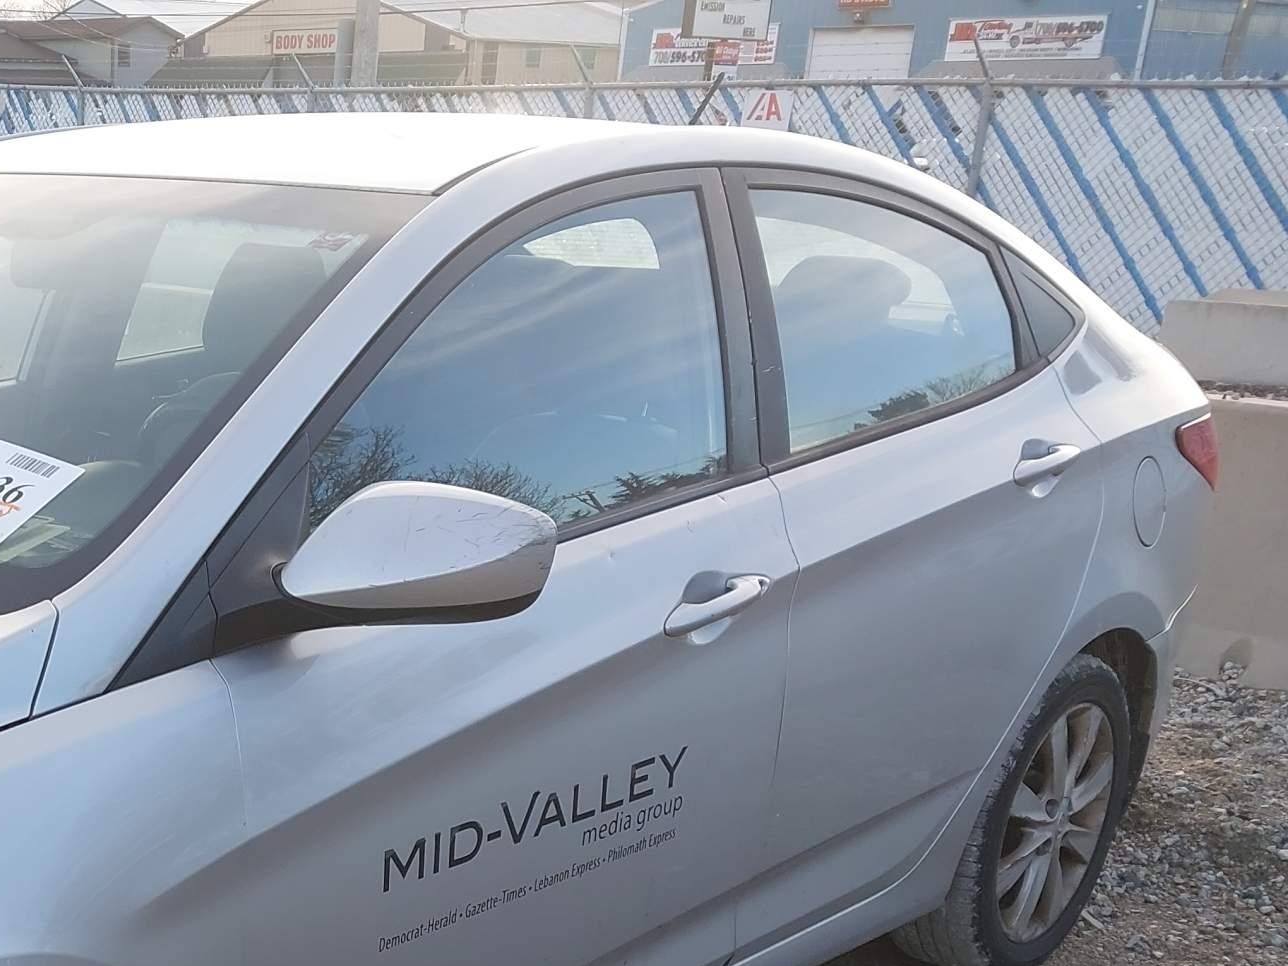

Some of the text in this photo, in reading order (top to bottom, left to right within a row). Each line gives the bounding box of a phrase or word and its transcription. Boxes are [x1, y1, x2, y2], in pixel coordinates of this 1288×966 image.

[275, 33, 336, 49] BODY SHOP
[722, 14, 745, 25] REPAIRS
[383, 746, 688, 893] MID-VALLEY
[582, 795, 683, 846] media group
[379, 827, 676, 952] Democrat-Herald Gazette-Times Lebanon Express Philomath Express
